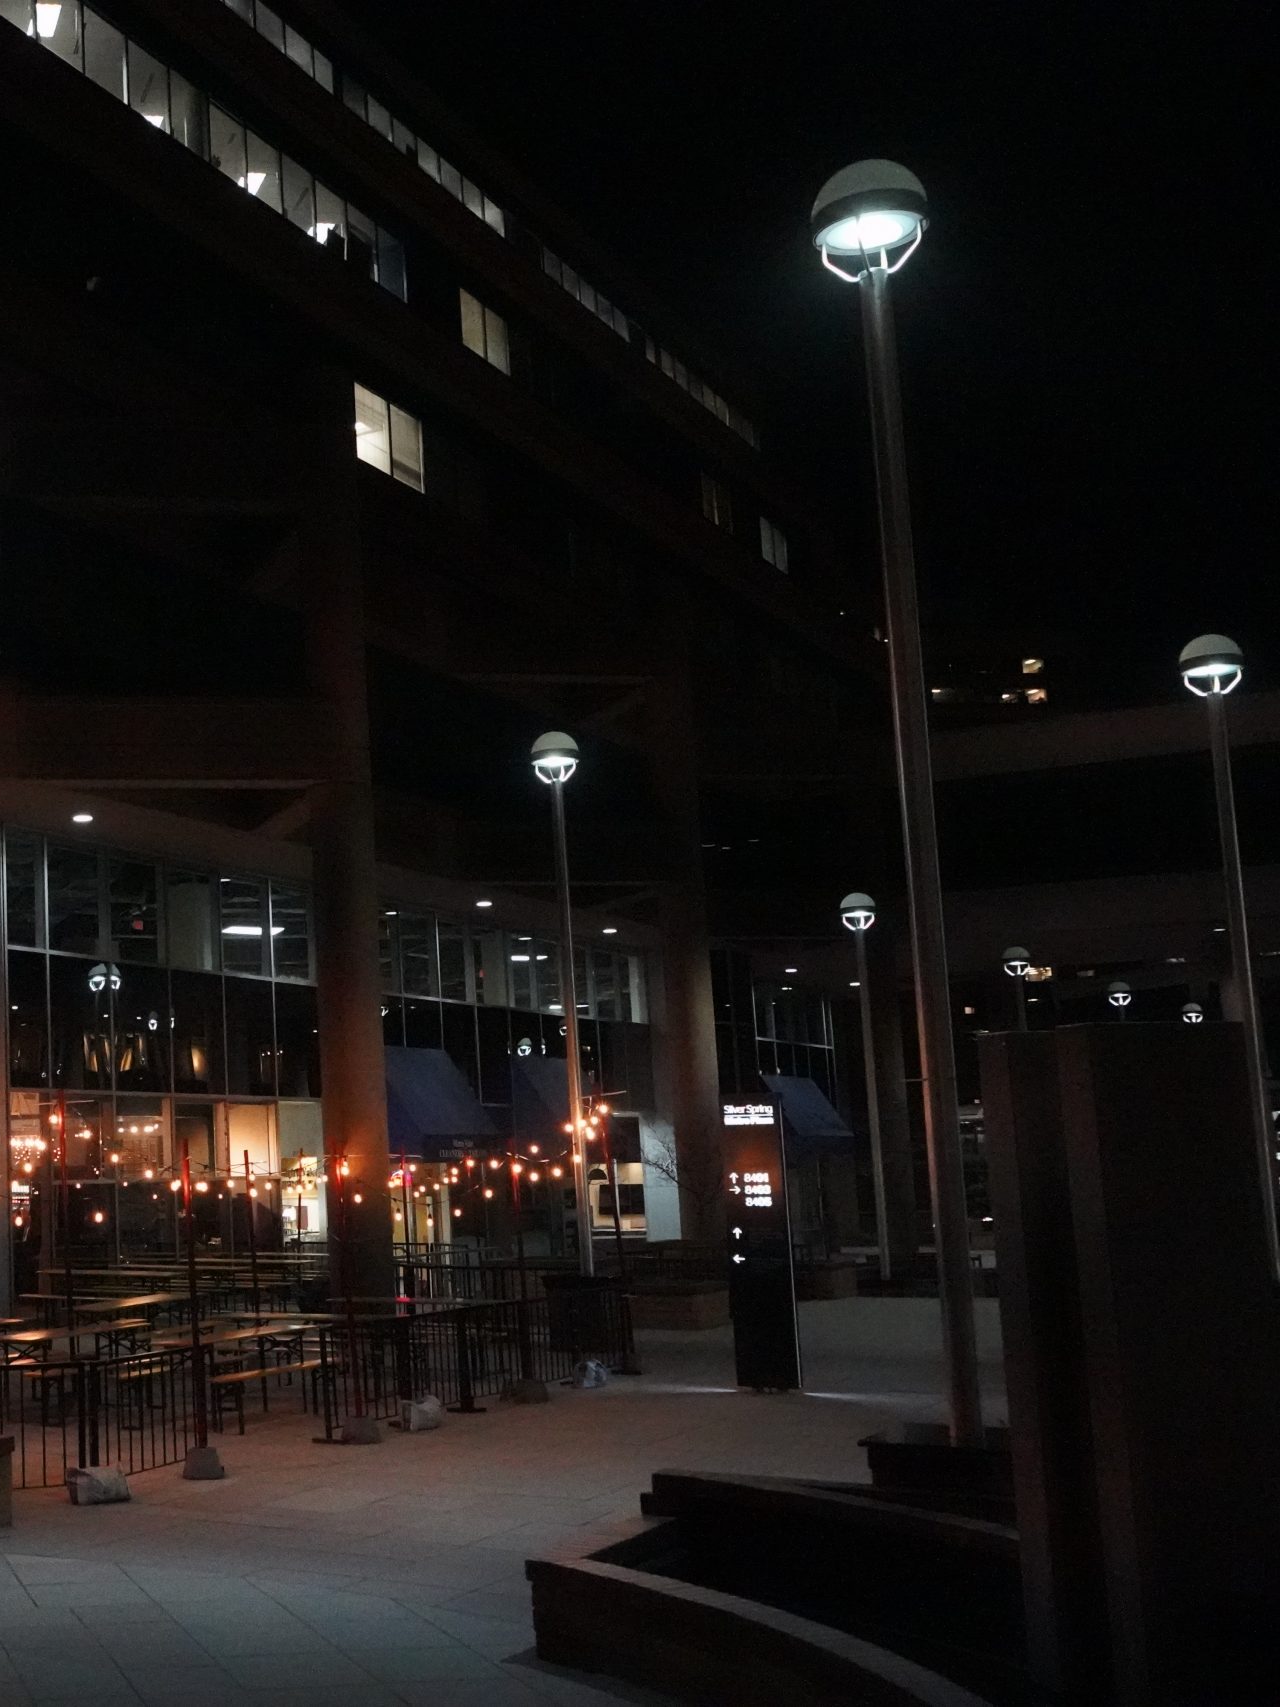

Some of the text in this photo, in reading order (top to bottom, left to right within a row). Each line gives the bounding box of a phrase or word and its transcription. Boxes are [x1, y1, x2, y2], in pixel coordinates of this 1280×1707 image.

[723, 1104, 773, 1116] Silver Spring
[743, 1172, 769, 1183] 8401
